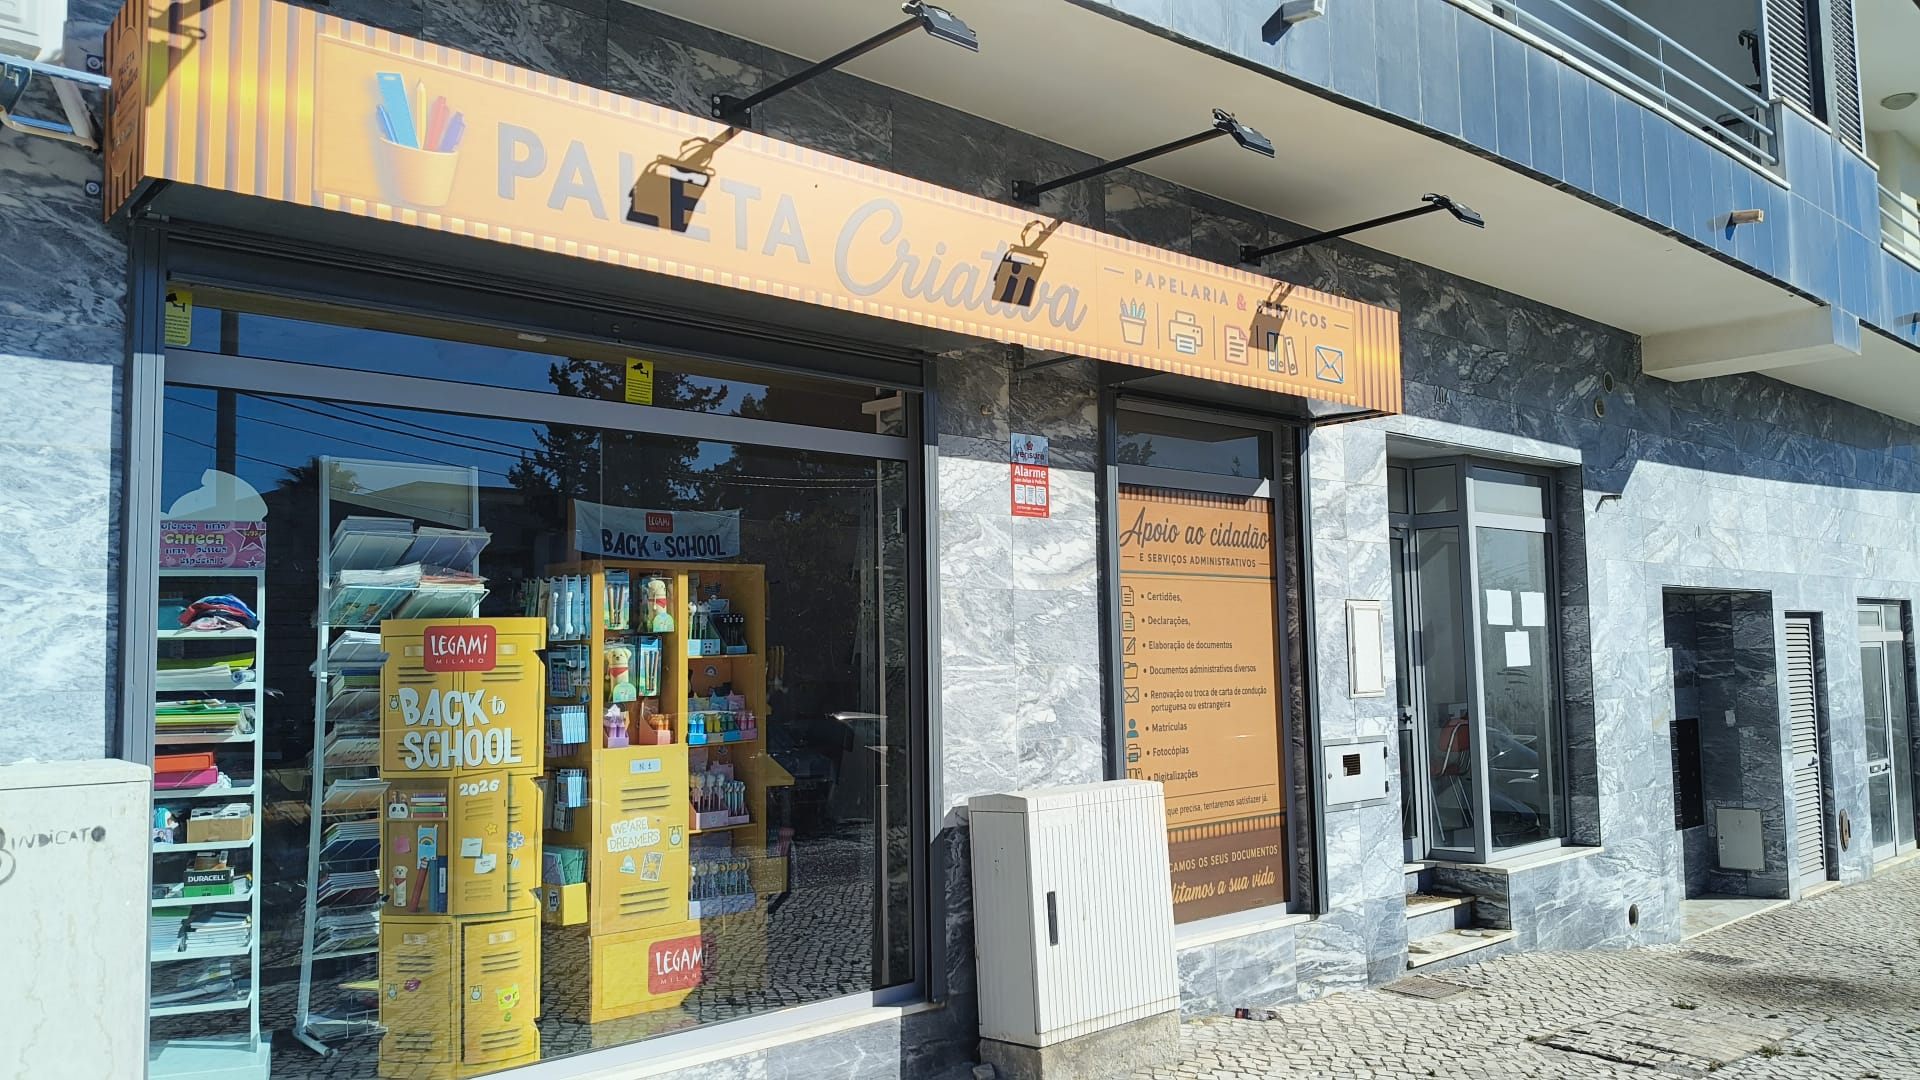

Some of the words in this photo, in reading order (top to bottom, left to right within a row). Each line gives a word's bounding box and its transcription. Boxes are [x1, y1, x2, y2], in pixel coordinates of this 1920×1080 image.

[498, 121, 811, 264] PALETA
[834, 198, 1088, 332] Criativa
[1134, 268, 1229, 306] PAPELARIA
[1236, 292, 1247, 311] &
[1014, 465, 1046, 478] Alarme
[1119, 506, 1181, 548] Apoio
[1185, 526, 1206, 545] ao
[1210, 522, 1270, 550] cidadão
[164, 533, 224, 545] caneca
[602, 529, 650, 557] BACK
[652, 540, 661, 551] to
[664, 534, 726, 558] SCHOOL
[1139, 553, 1144, 562] E
[1147, 553, 1187, 566] SERVIÇOS
[1190, 556, 1256, 568] ADMINISTRATIVOS
[1147, 592, 1183, 604] Certidões,
[1148, 615, 1191, 627] Declarações,
[1148, 640, 1185, 651] Elaboração
[1186, 640, 1195, 649] de
[1196, 640, 1233, 649] documentos
[1149, 664, 1188, 675] Documentos
[1189, 664, 1233, 674] administrativos
[1234, 664, 1256, 673] diversos
[1150, 690, 1184, 701] Renovação
[1185, 691, 1193, 699] ou
[1193, 688, 1209, 697] troca
[1210, 688, 1218, 696] de
[1219, 687, 1233, 696] carta
[1233, 687, 1241, 695] de
[1241, 686, 1267, 697] condução
[398, 687, 490, 728] BACK
[488, 695, 506, 715] to
[1151, 703, 1187, 714] portuguesa
[1197, 700, 1231, 712] estrangeira
[1151, 721, 1188, 732] Matrículas
[403, 728, 522, 770] SCHOOL
[1152, 745, 1189, 757] Fotocópias
[1153, 769, 1199, 783] Digitalizações
[459, 779, 500, 797] 2026
[1179, 803, 1203, 815] precisa,
[1203, 799, 1235, 810] tentaremos
[1236, 794, 1261, 805] satisfazer
[613, 822, 627, 835] WE
[628, 818, 647, 832] ARE
[609, 831, 659, 850] DREAMERS
[1198, 857, 1209, 868] OS
[1210, 855, 1229, 867] SEUS
[1231, 844, 1278, 862] DOCUMENTOS
[187, 874, 226, 883] DURACELL
[1217, 881, 1226, 895] a
[1228, 876, 1250, 892] sua
[1251, 865, 1276, 888] vida
[660, 973, 698, 985] MILAN
